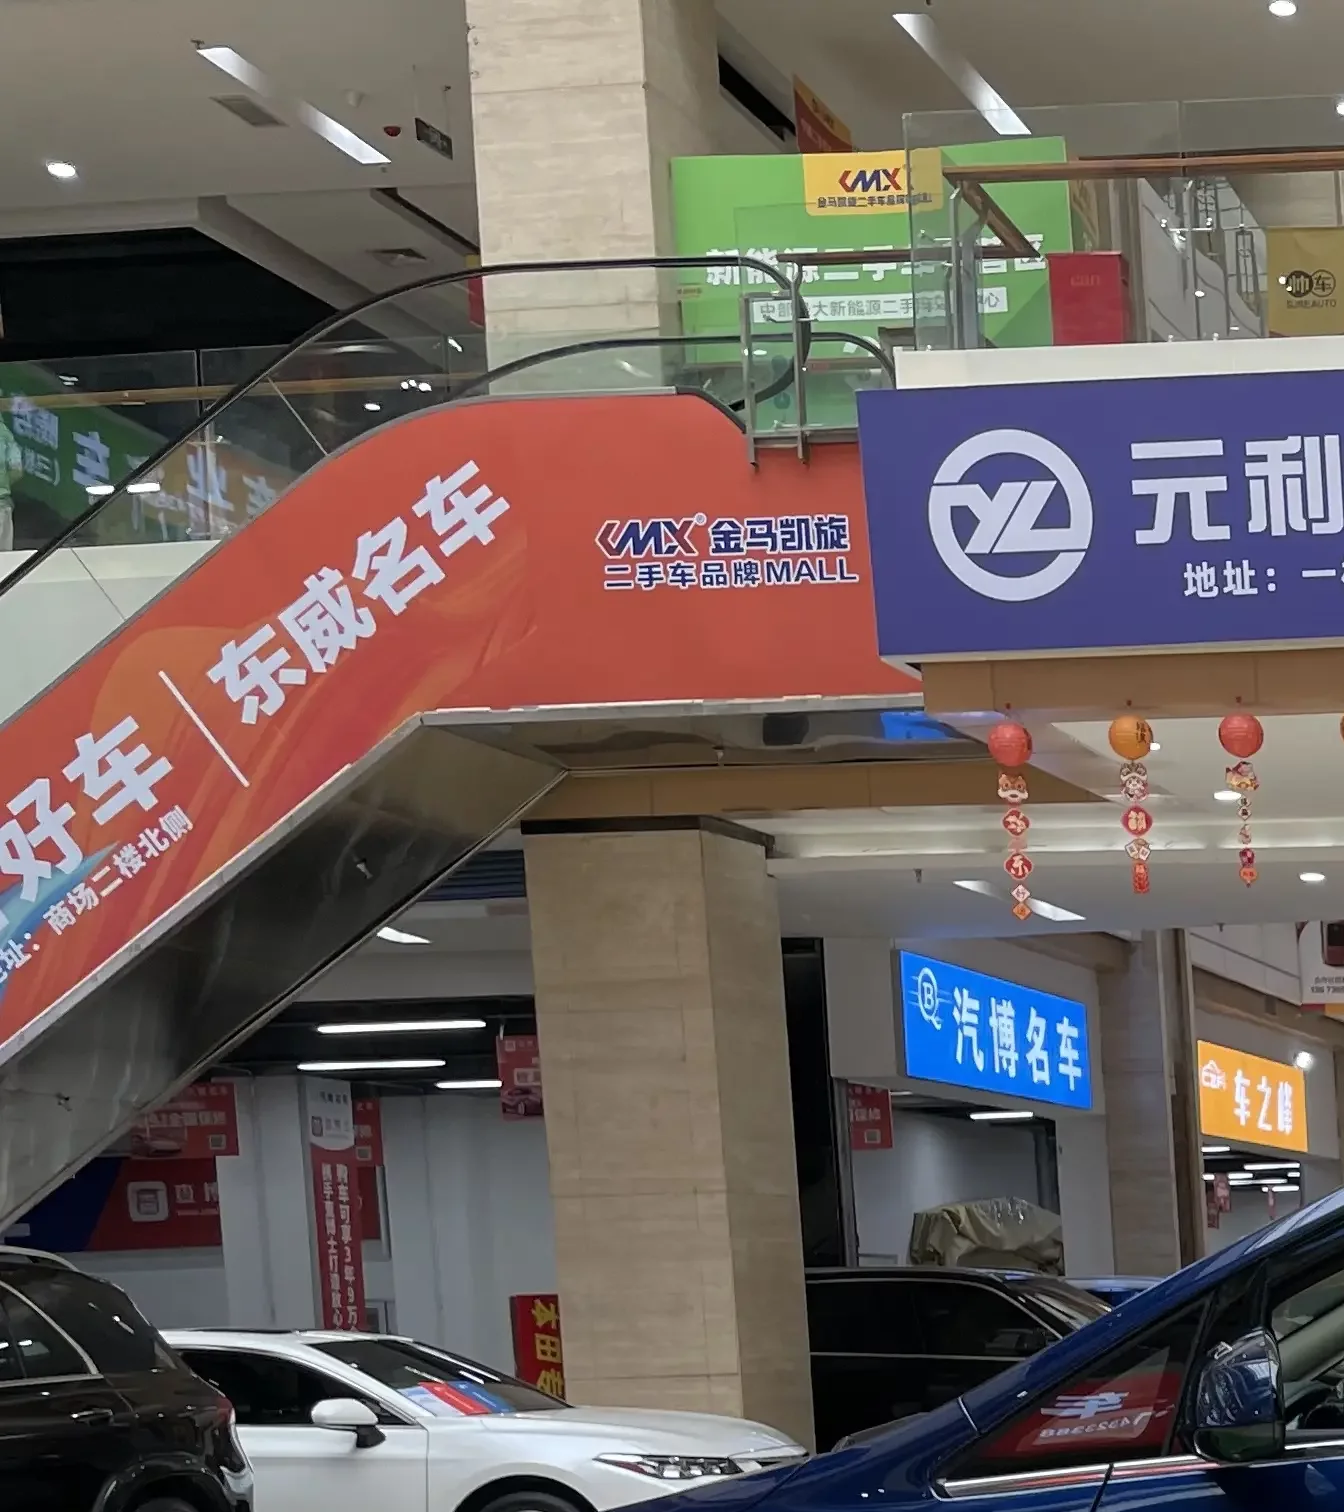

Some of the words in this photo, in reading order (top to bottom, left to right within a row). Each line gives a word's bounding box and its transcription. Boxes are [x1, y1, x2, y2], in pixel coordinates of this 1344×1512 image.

[708, 514, 850, 556] 金马凯旋
[602, 556, 859, 593] 二手车品牌MALL
[0, 714, 175, 931] 好车
[206, 457, 512, 728] 东威名车
[952, 985, 1083, 1092] 汽博名车
